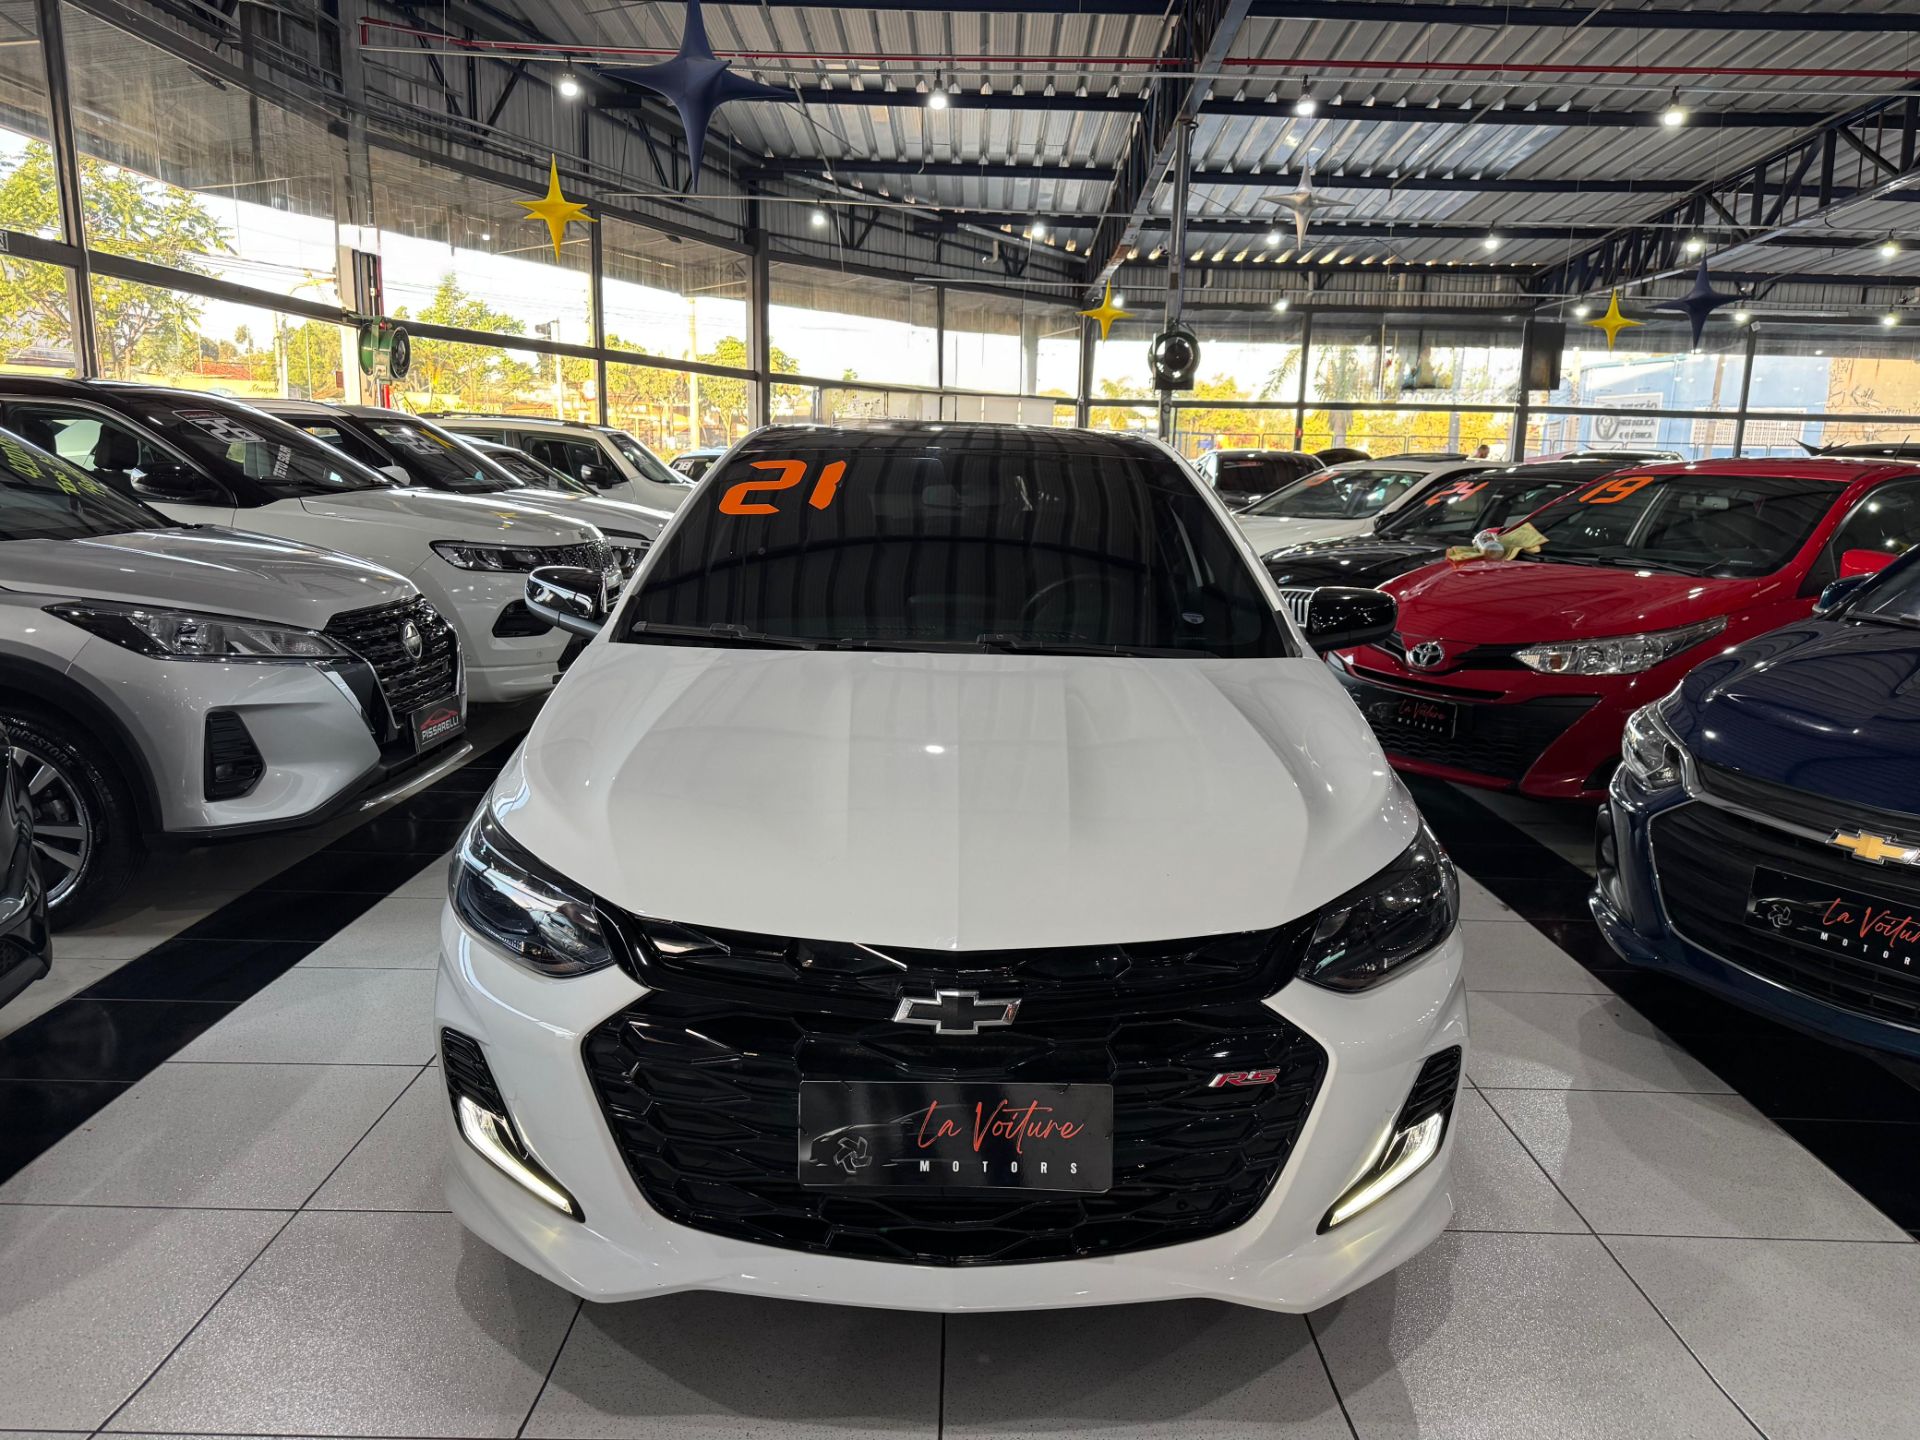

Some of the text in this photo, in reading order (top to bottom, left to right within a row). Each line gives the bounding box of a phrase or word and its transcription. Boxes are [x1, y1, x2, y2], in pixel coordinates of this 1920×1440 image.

[719, 460, 847, 515] 21
[1426, 481, 1489, 505] 24
[1579, 476, 1655, 504] 19
[421, 715, 459, 741] PISSARELLI
[1823, 898, 1920, 948] La Voitur
[1820, 932, 1911, 965] MOTOR
[1208, 1066, 1280, 1088] RS
[917, 1099, 1085, 1154] La Voiture
[919, 1160, 1078, 1175] MOTORS
